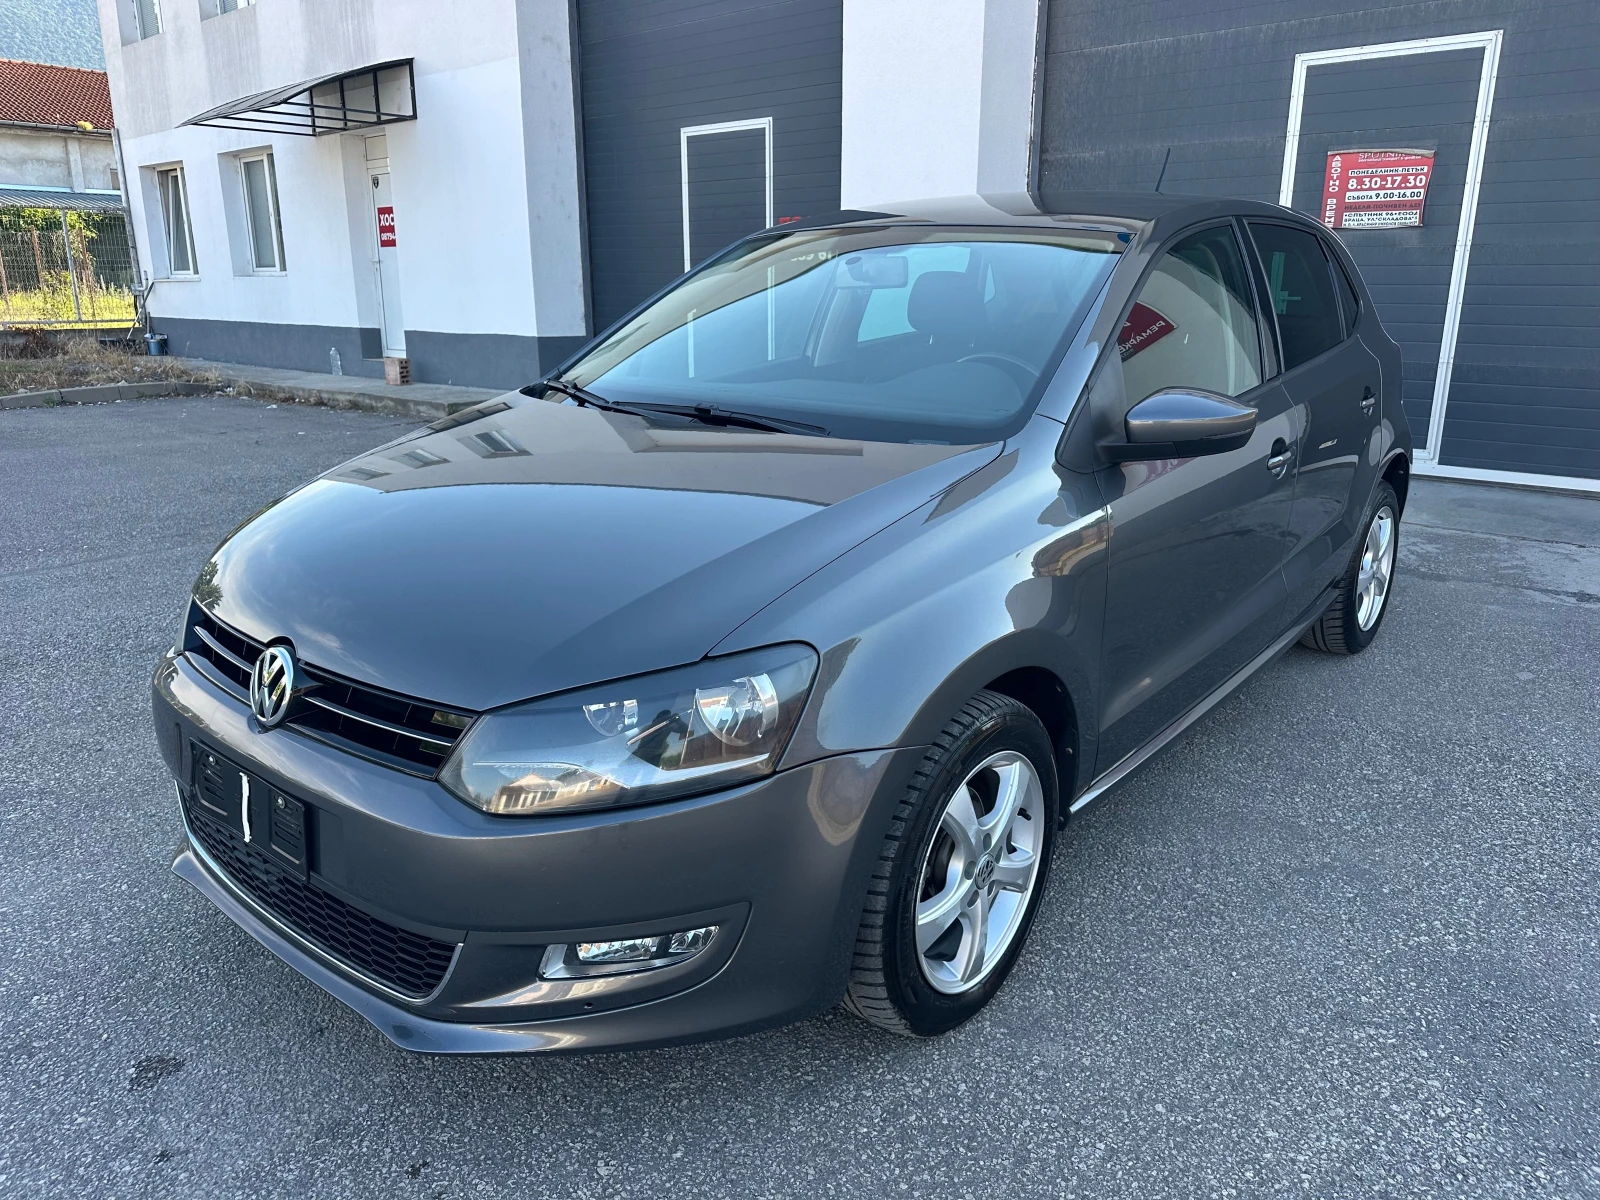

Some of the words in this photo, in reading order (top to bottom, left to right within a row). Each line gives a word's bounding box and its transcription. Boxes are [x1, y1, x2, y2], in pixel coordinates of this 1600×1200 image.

[1350, 167, 1425, 175] ПОНЕДЕЛНИК-ПЕТЪК
[1348, 175, 1426, 189] 8.30-17.30
[1375, 191, 1422, 199] 9.00-16.00
